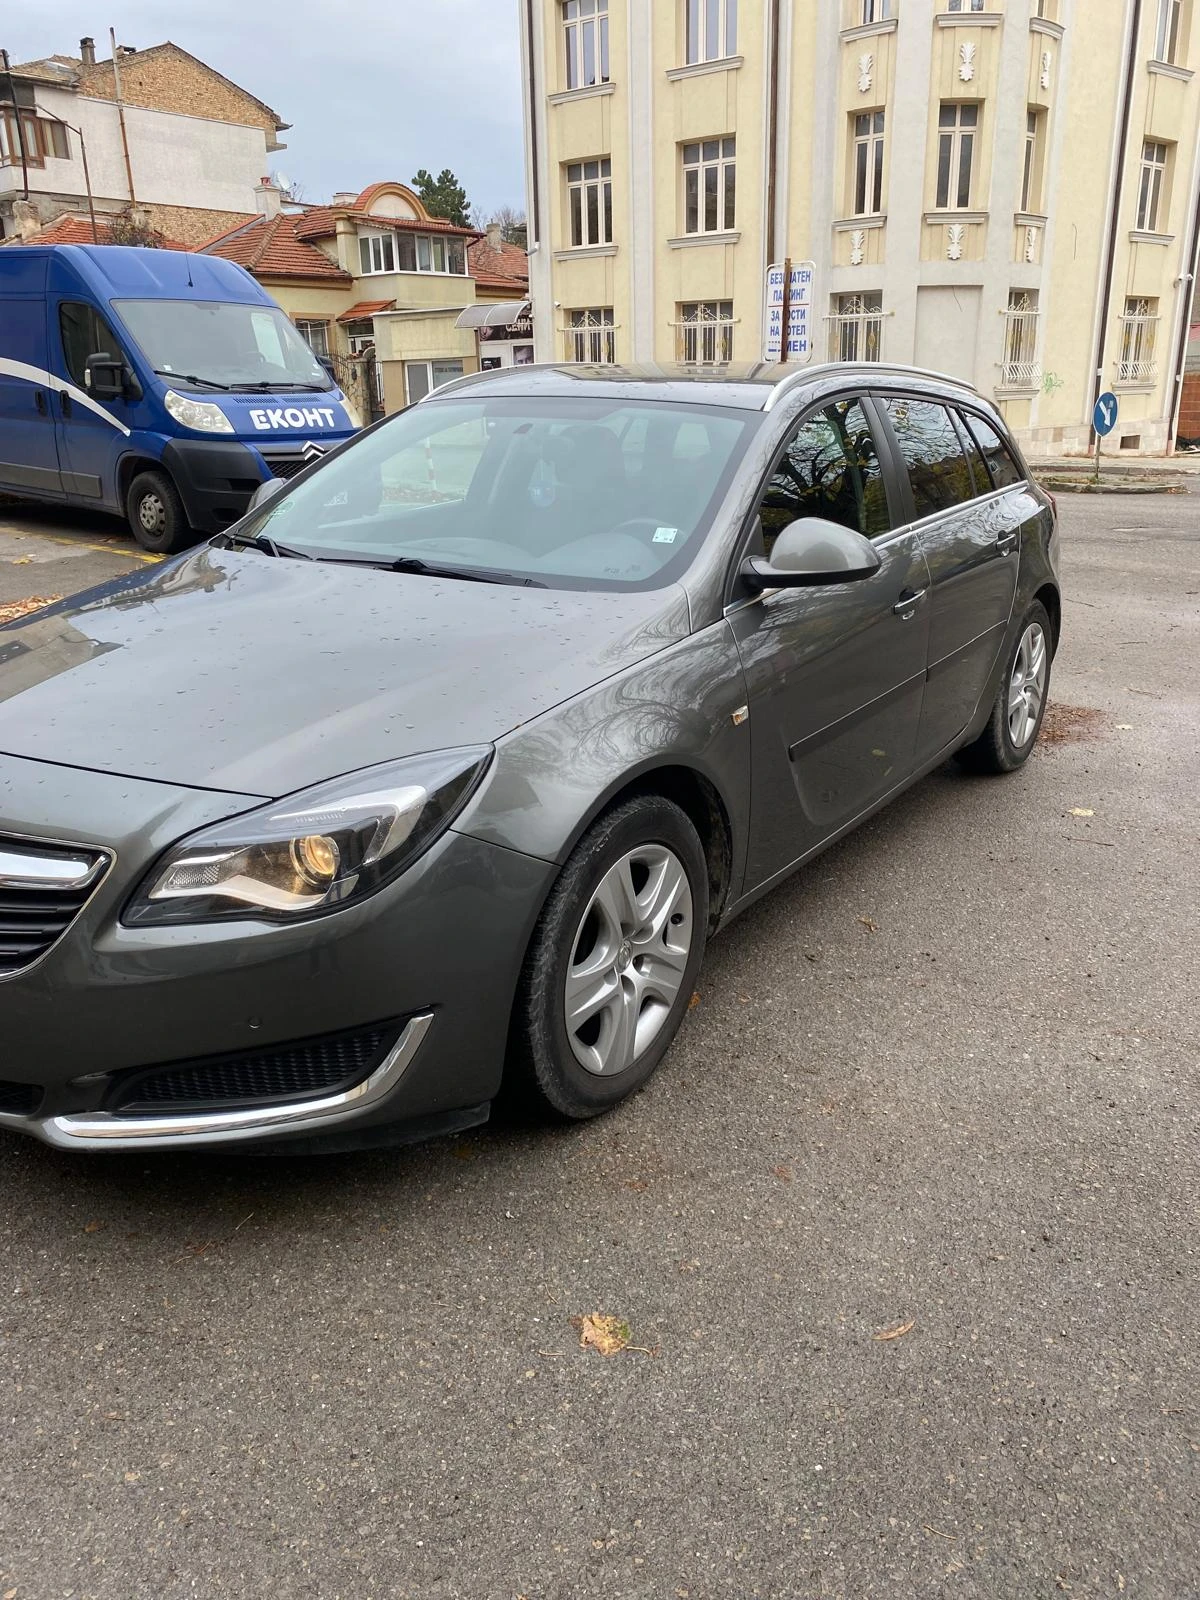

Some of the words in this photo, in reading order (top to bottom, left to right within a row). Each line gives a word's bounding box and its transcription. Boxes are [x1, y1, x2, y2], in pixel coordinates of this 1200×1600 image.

[770, 271, 811, 285] БЕЗАТЕН
[770, 310, 780, 321] ЗА
[770, 326, 780, 336] НА
[787, 324, 806, 336] ОТЕЛ
[249, 408, 335, 430] ЕКОНТ
